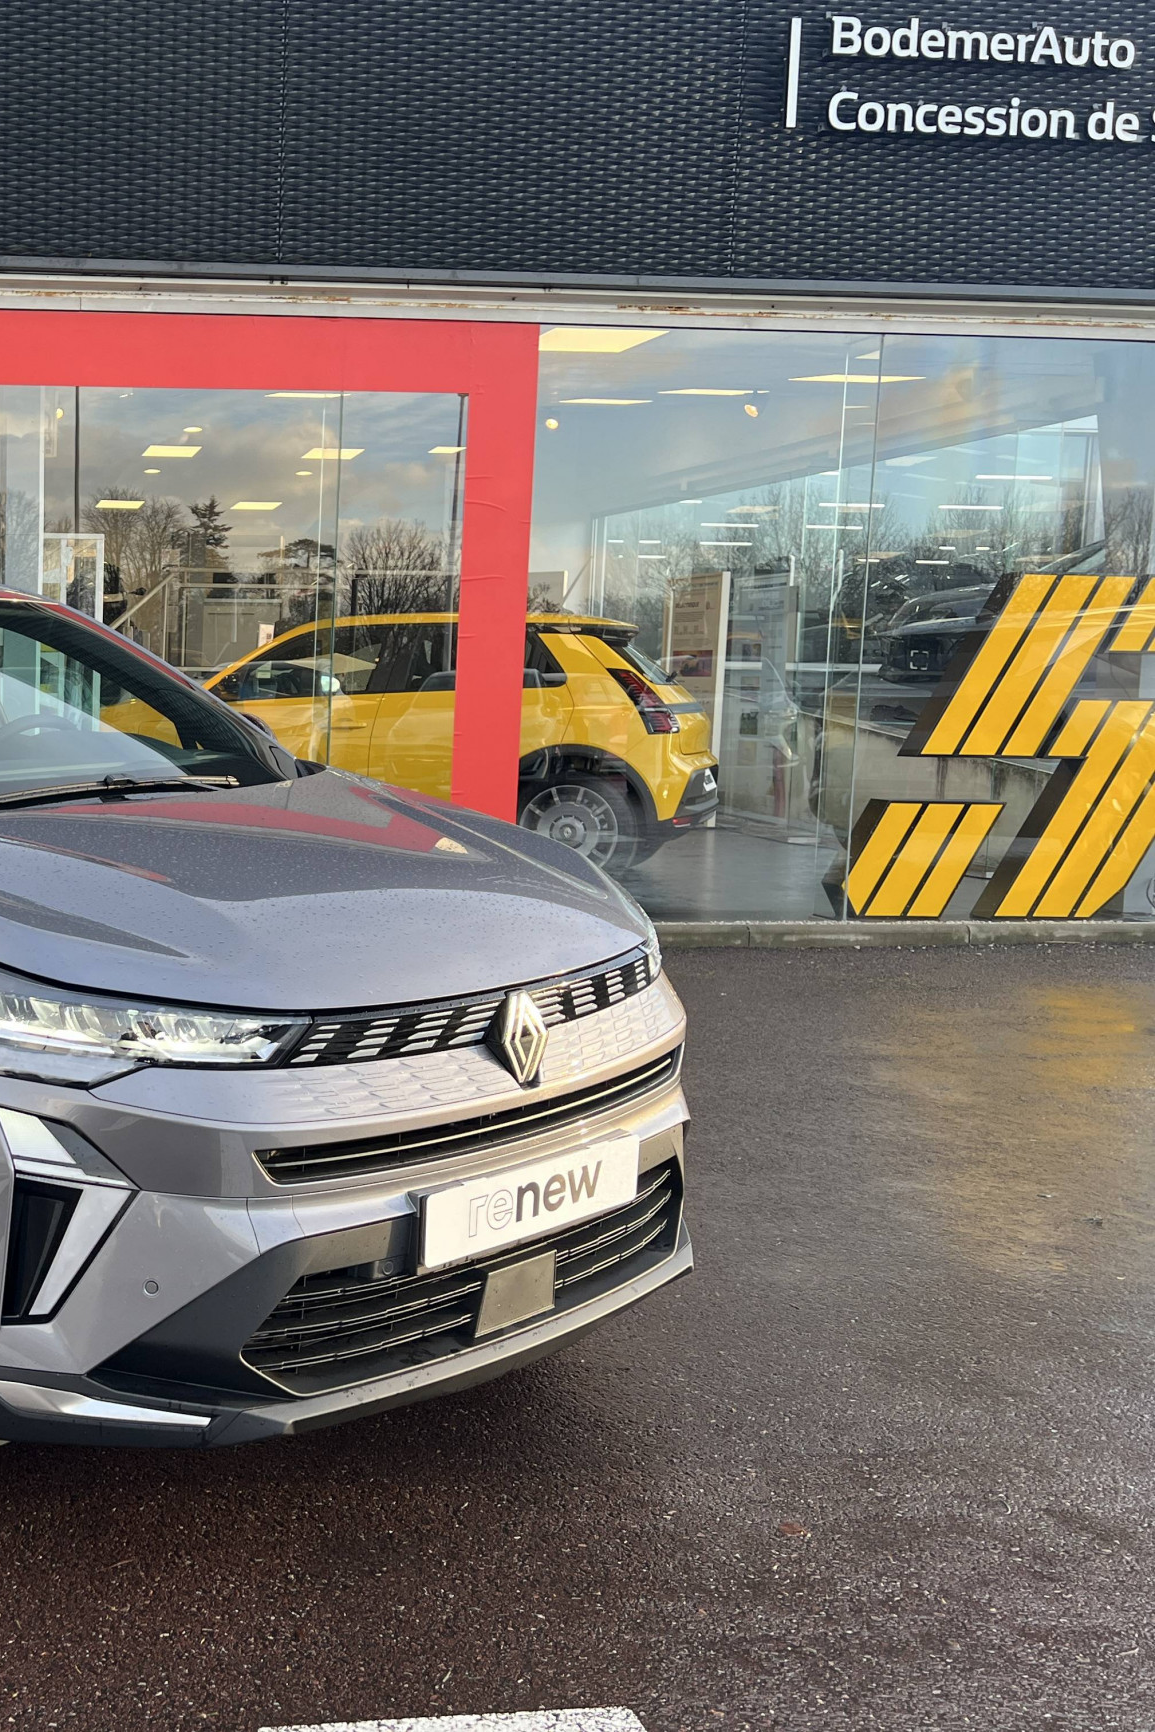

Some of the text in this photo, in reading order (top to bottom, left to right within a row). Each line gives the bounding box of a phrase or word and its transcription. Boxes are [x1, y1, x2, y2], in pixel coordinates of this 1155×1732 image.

[830, 16, 1136, 69] BodemerAuto
[828, 91, 1075, 139] Concession
[1086, 101, 1140, 142] de
[468, 1160, 603, 1239] renew
